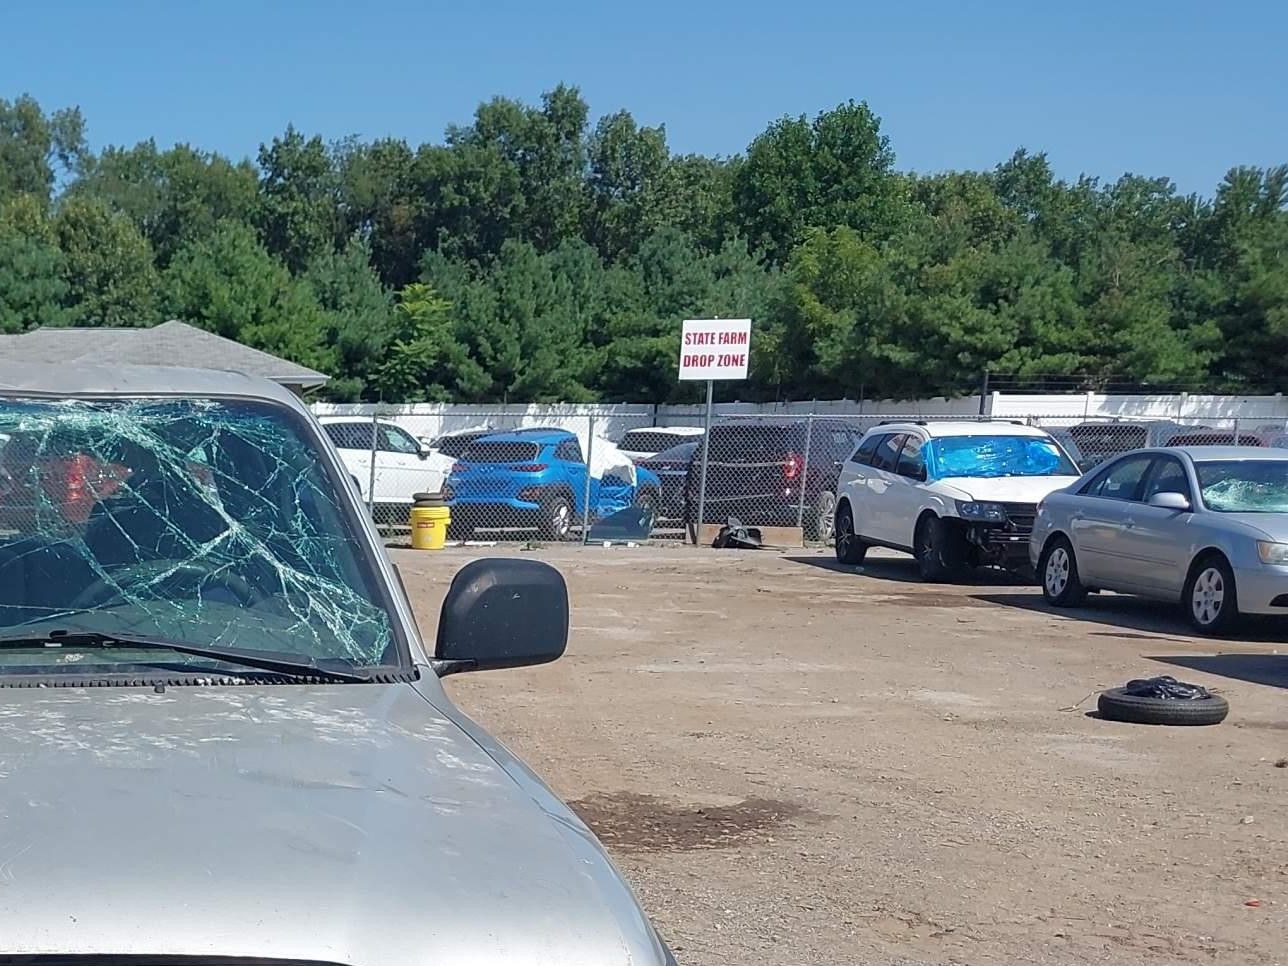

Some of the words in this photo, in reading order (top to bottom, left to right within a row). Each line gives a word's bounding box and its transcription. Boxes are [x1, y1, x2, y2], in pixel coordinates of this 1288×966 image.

[685, 332, 715, 345] STATE
[719, 332, 747, 344] FARM
[683, 355, 714, 367] DROP
[717, 354, 745, 366] ZONE
